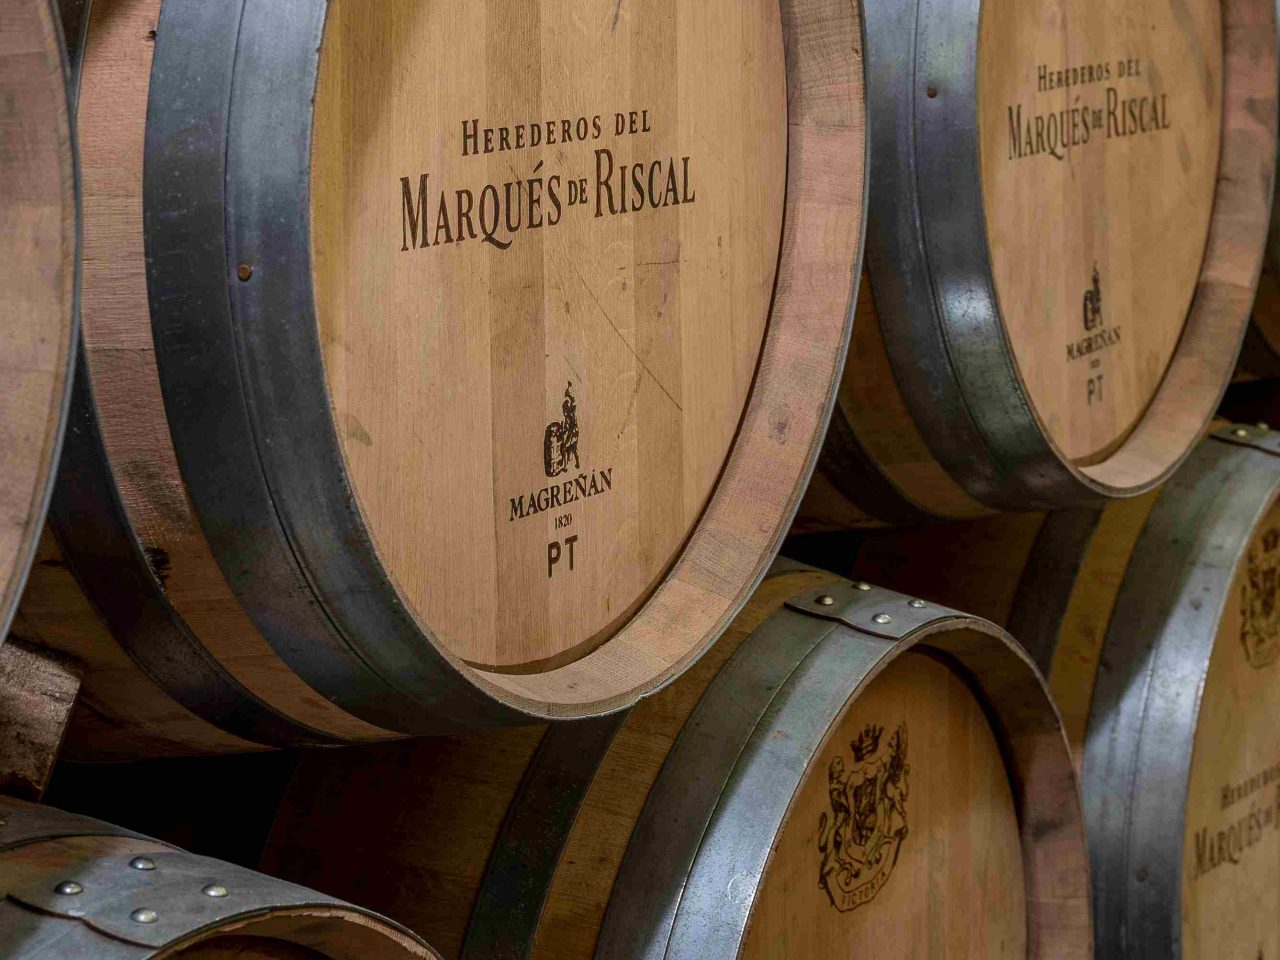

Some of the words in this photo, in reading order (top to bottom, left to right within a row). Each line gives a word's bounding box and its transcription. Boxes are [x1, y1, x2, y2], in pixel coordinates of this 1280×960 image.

[1037, 62, 1111, 93] HEREDEROS
[1117, 58, 1142, 79] DEL
[461, 115, 602, 157] HEREDEROS
[613, 109, 652, 137] DEL
[1007, 95, 1090, 161] MARQUÉS
[1106, 87, 1172, 139] RISCAL
[400, 159, 562, 252] MARQUÉS
[567, 178, 588, 207] DE
[594, 147, 696, 219] RISCAL
[554, 513, 573, 530] 1820
[547, 534, 578, 579] PT
